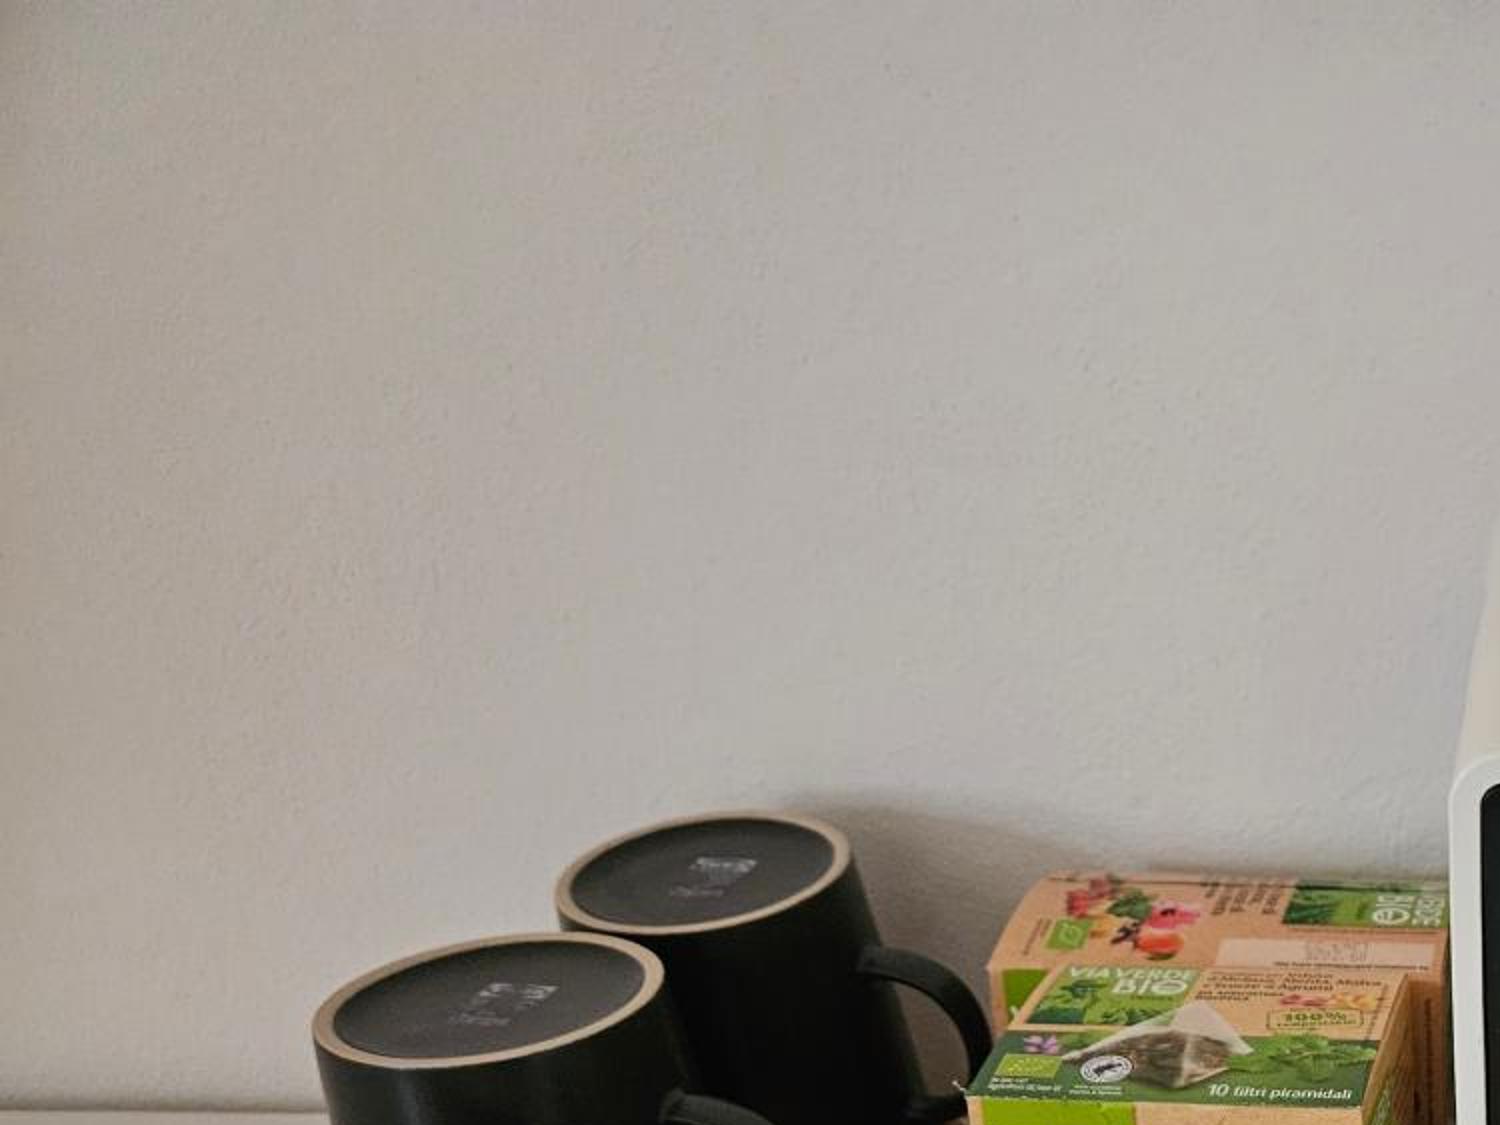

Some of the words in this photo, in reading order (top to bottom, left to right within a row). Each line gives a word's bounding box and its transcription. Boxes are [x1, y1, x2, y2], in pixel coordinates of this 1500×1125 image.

[1112, 979, 1188, 996] BIO
[1208, 1083, 1231, 1097] 10
[1233, 1084, 1267, 1098] filtri
[1269, 1086, 1353, 1101] piramidali
